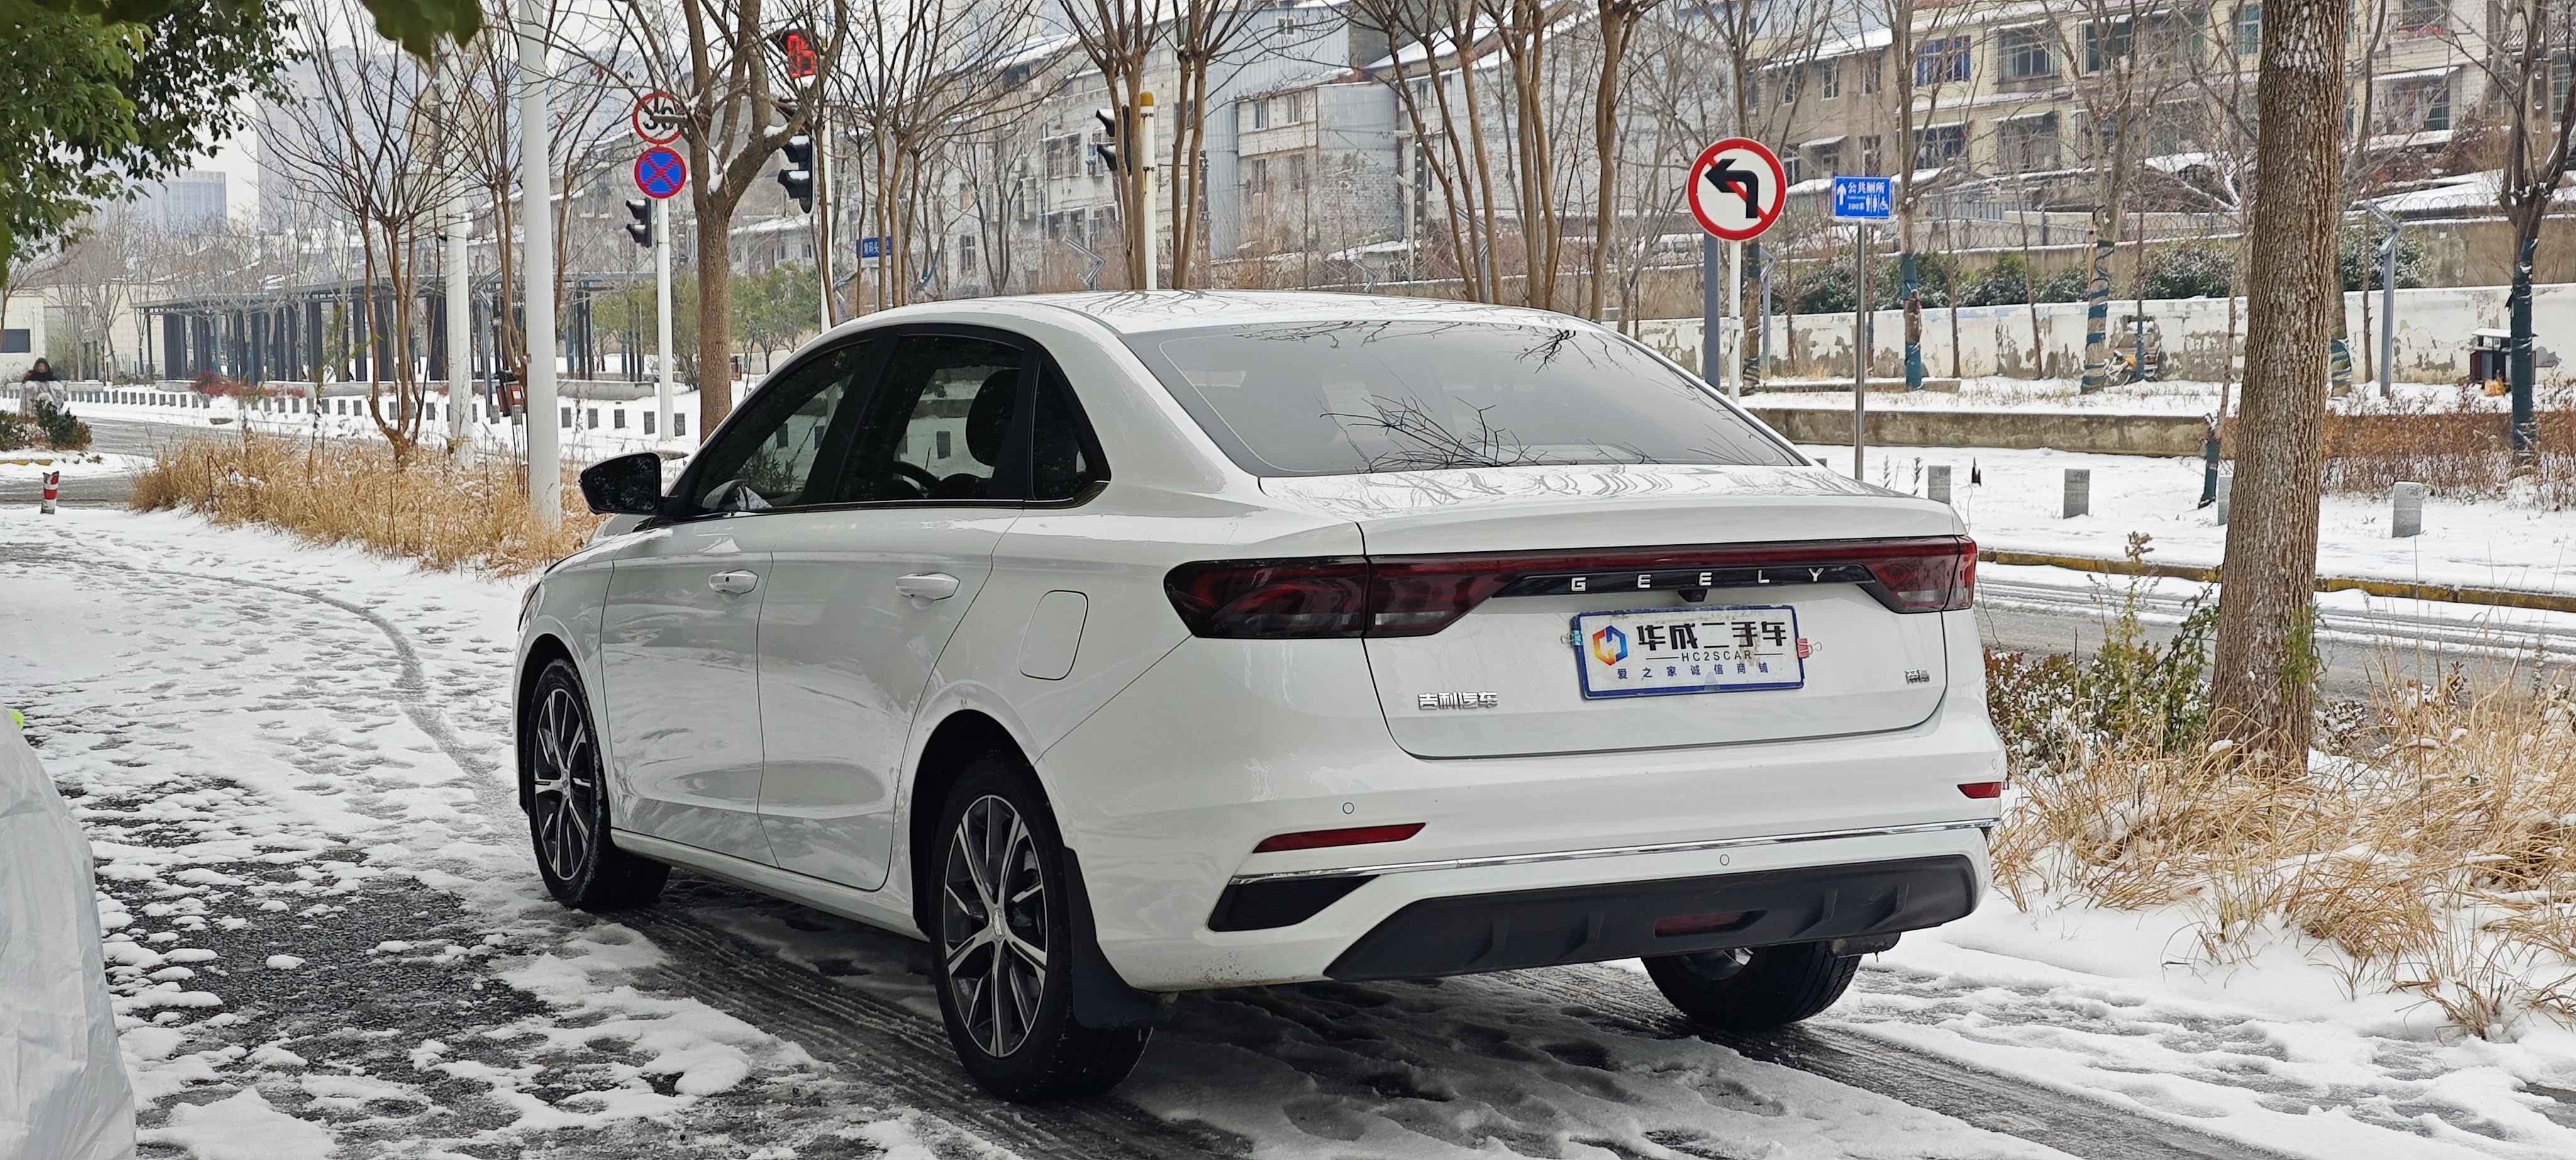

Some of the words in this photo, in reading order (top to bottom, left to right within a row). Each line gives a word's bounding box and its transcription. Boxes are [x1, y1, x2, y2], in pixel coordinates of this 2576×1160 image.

[1847, 181, 1885, 194] 公共厕所
[1571, 567, 1823, 591] GEELY
[1636, 621, 1787, 651] 华成二手车
[1682, 650, 1752, 662] HC2SCAR
[1617, 662, 1768, 679] 爱之家诚信商铺
[1418, 691, 1498, 710] 吉利汽车
